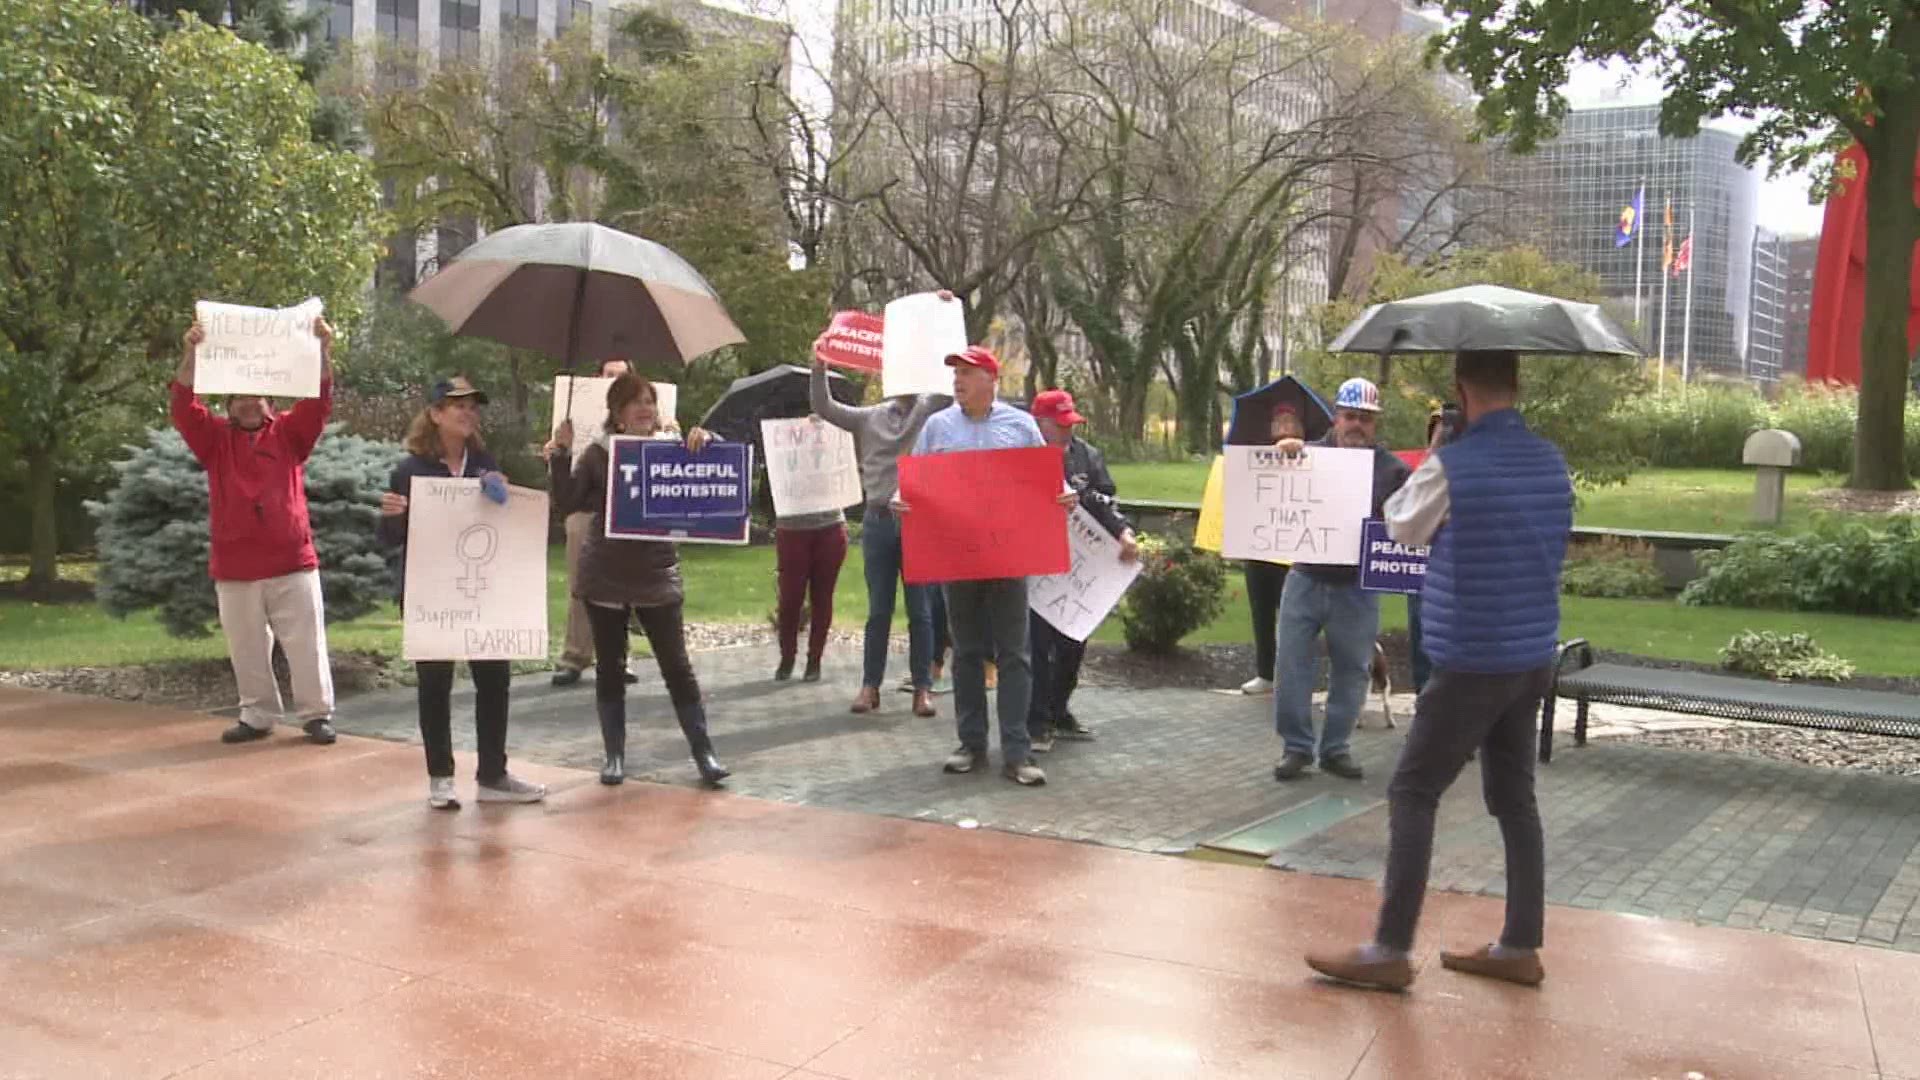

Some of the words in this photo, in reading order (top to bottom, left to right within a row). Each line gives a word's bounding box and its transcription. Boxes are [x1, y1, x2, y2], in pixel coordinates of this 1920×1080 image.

[829, 327, 882, 342] PEACEF
[650, 463, 738, 478] PEACEFUL
[426, 481, 480, 504] Suppor
[650, 484, 738, 499] PROTESTER
[1255, 473, 1324, 504] FILL
[1269, 507, 1312, 525] THAT
[1251, 525, 1340, 555] SEAT
[1371, 541, 1431, 557] PEACEF
[1370, 560, 1427, 575] PROTES
[415, 604, 481, 630] Support
